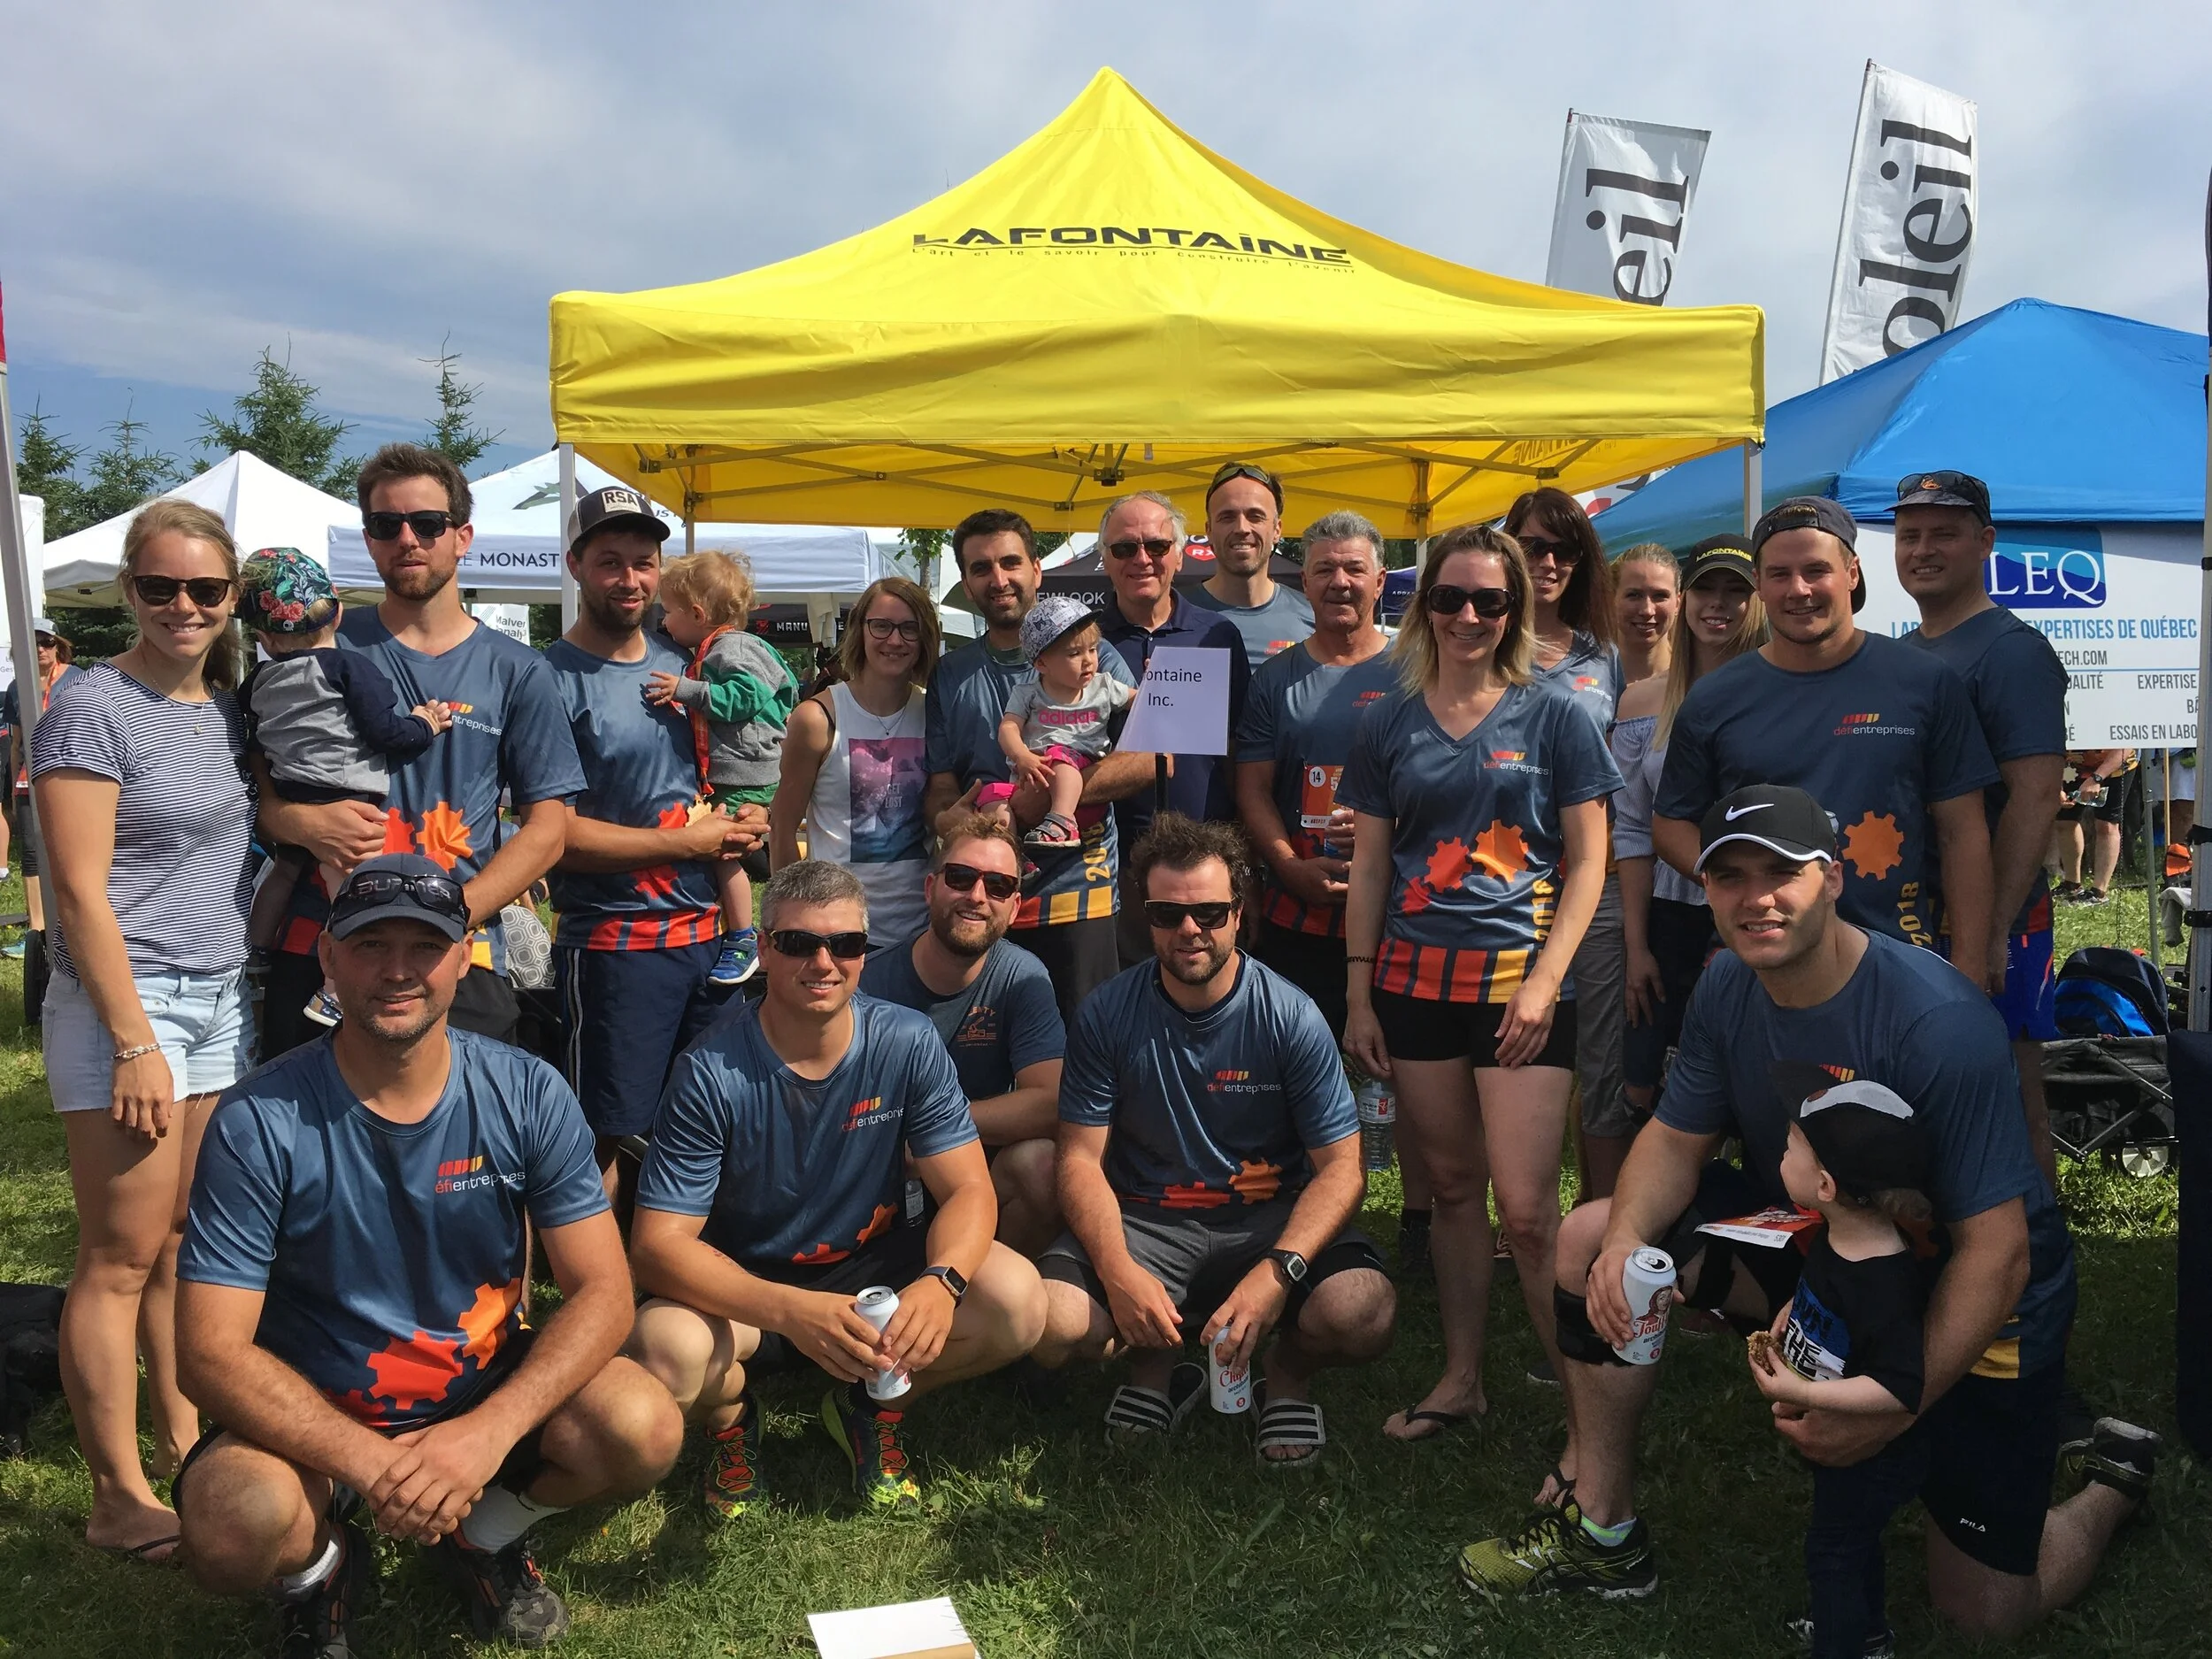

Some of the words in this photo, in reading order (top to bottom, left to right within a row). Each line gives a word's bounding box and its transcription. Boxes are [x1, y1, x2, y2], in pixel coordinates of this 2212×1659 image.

[604, 491, 638, 506] RSA
[480, 552, 560, 567] MONAST
[1988, 549, 2103, 605] LEQ
[2024, 619, 2114, 639] XPERTISES
[2118, 618, 2137, 639] DE
[2140, 615, 2198, 639] QUÉBEC
[1143, 667, 1202, 682] ontaine
[2138, 673, 2197, 689] EXPERTISE
[1148, 692, 1174, 707] Inc.
[1038, 709, 1099, 726] adidas
[2110, 726, 2149, 741] ESSAIS
[2152, 725, 2166, 740] EN
[1312, 771, 1322, 783] 14
